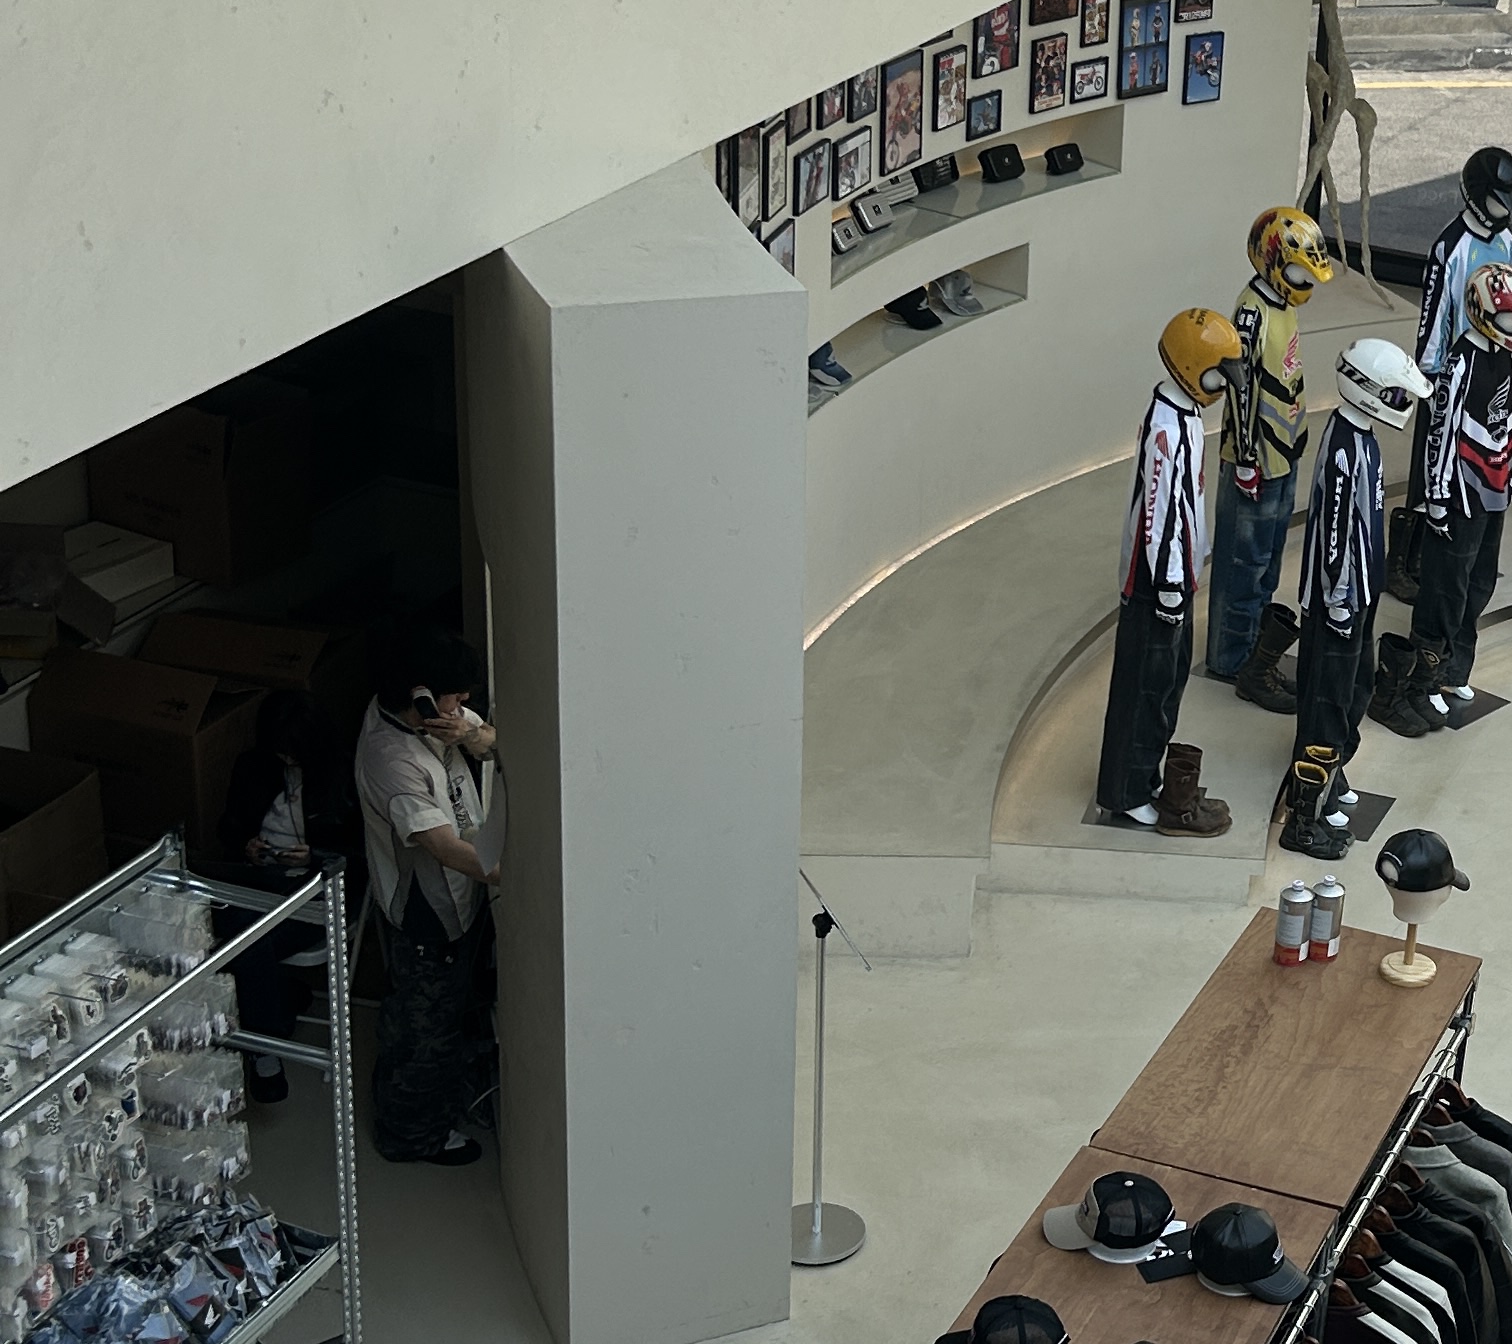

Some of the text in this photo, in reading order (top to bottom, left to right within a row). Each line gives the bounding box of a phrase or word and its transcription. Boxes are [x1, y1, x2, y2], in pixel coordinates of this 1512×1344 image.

[1418, 264, 1440, 338] HONDA
[1145, 458, 1162, 546] HONDA
[1328, 475, 1345, 566] HONDA
